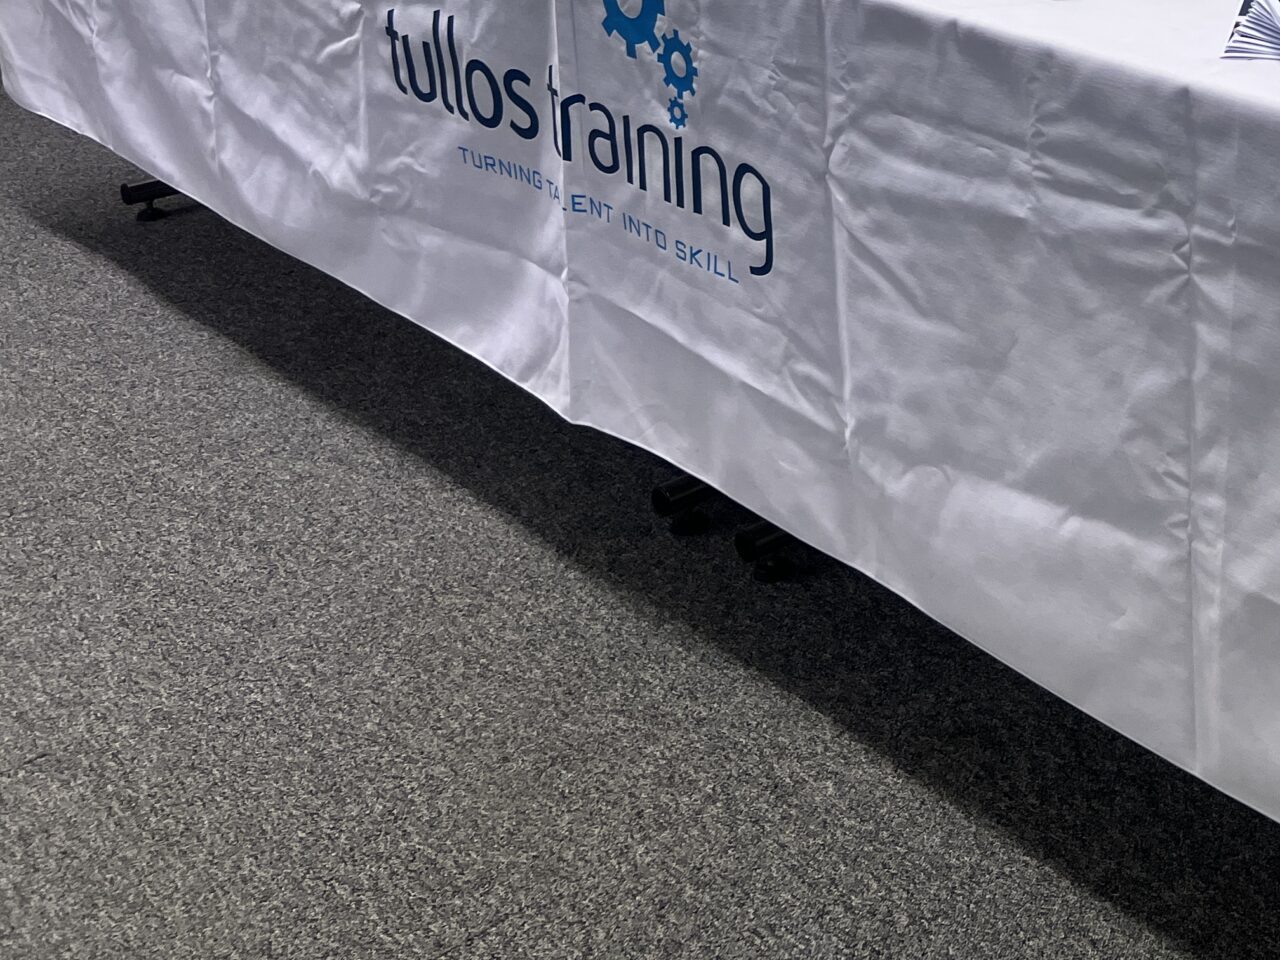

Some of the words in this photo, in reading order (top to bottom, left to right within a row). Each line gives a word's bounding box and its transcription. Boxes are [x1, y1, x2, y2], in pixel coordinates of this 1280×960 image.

[386, 8, 539, 140] tullos
[547, 64, 774, 277] training
[458, 146, 543, 190] TURNING
[622, 212, 667, 250] INTO
[675, 240, 739, 284] SKILL
